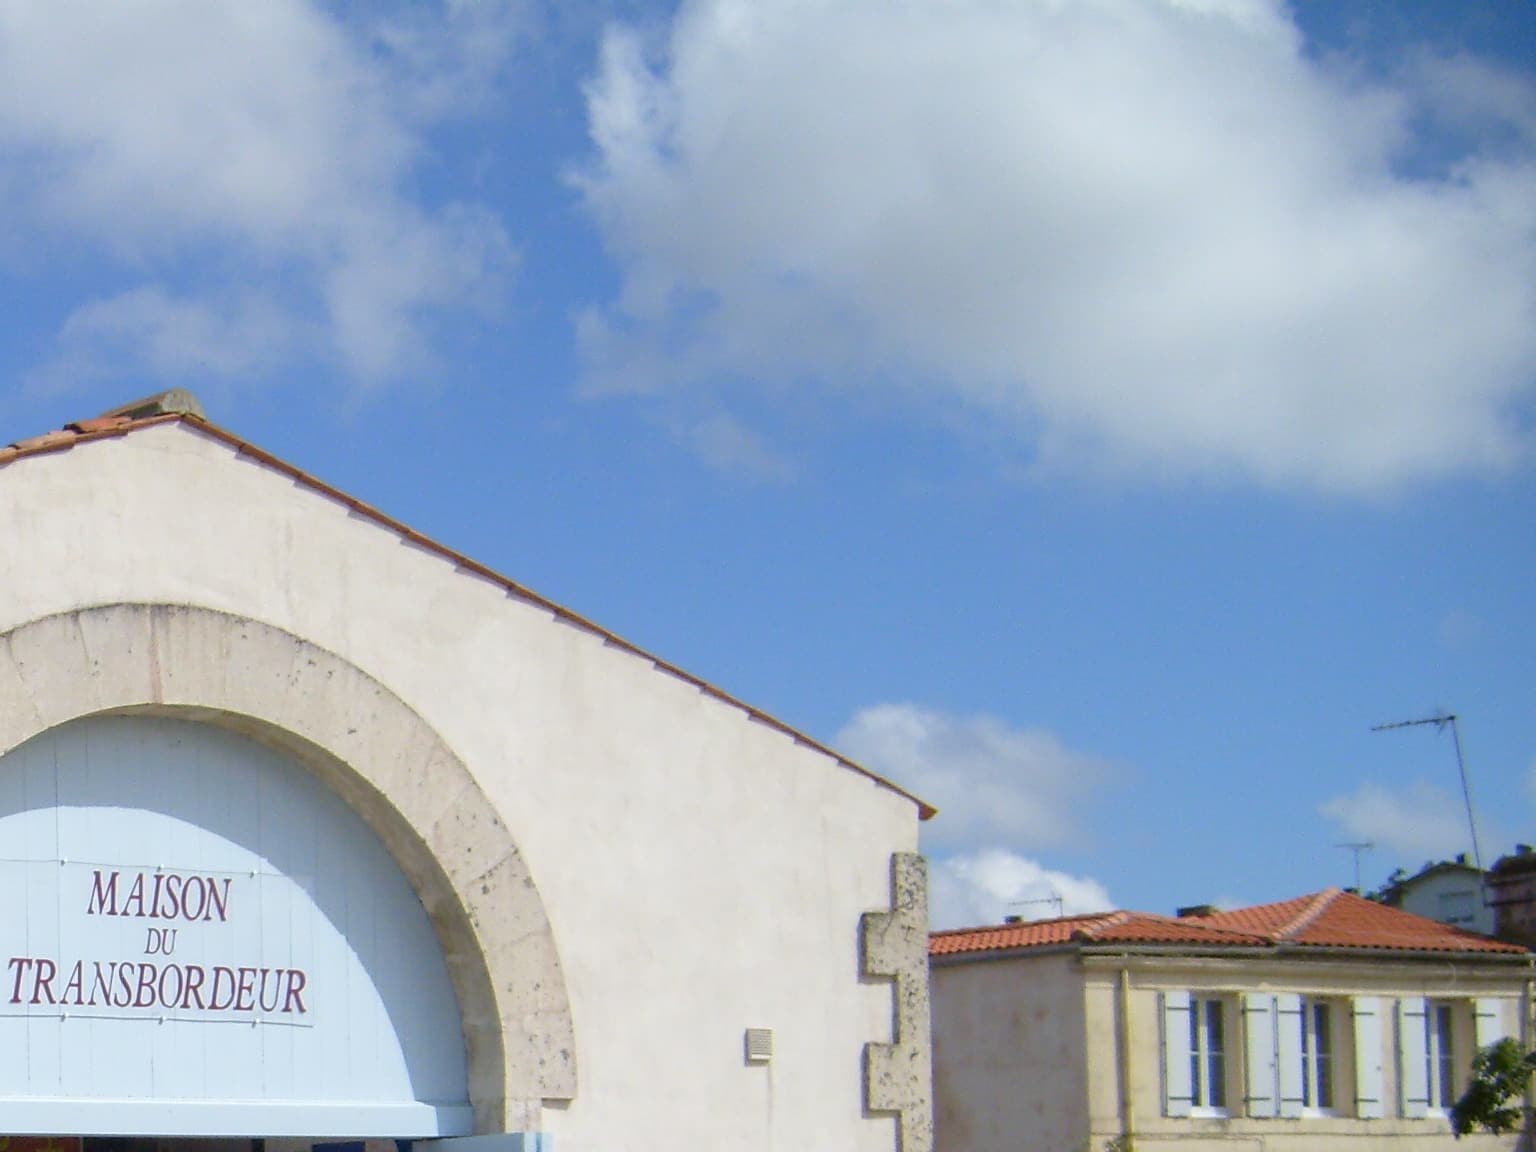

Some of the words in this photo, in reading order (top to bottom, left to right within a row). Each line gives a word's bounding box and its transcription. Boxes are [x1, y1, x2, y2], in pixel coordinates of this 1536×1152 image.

[87, 870, 232, 921] MAISON
[144, 927, 177, 955] DU
[7, 957, 307, 1014] TRANSBORDEUR
